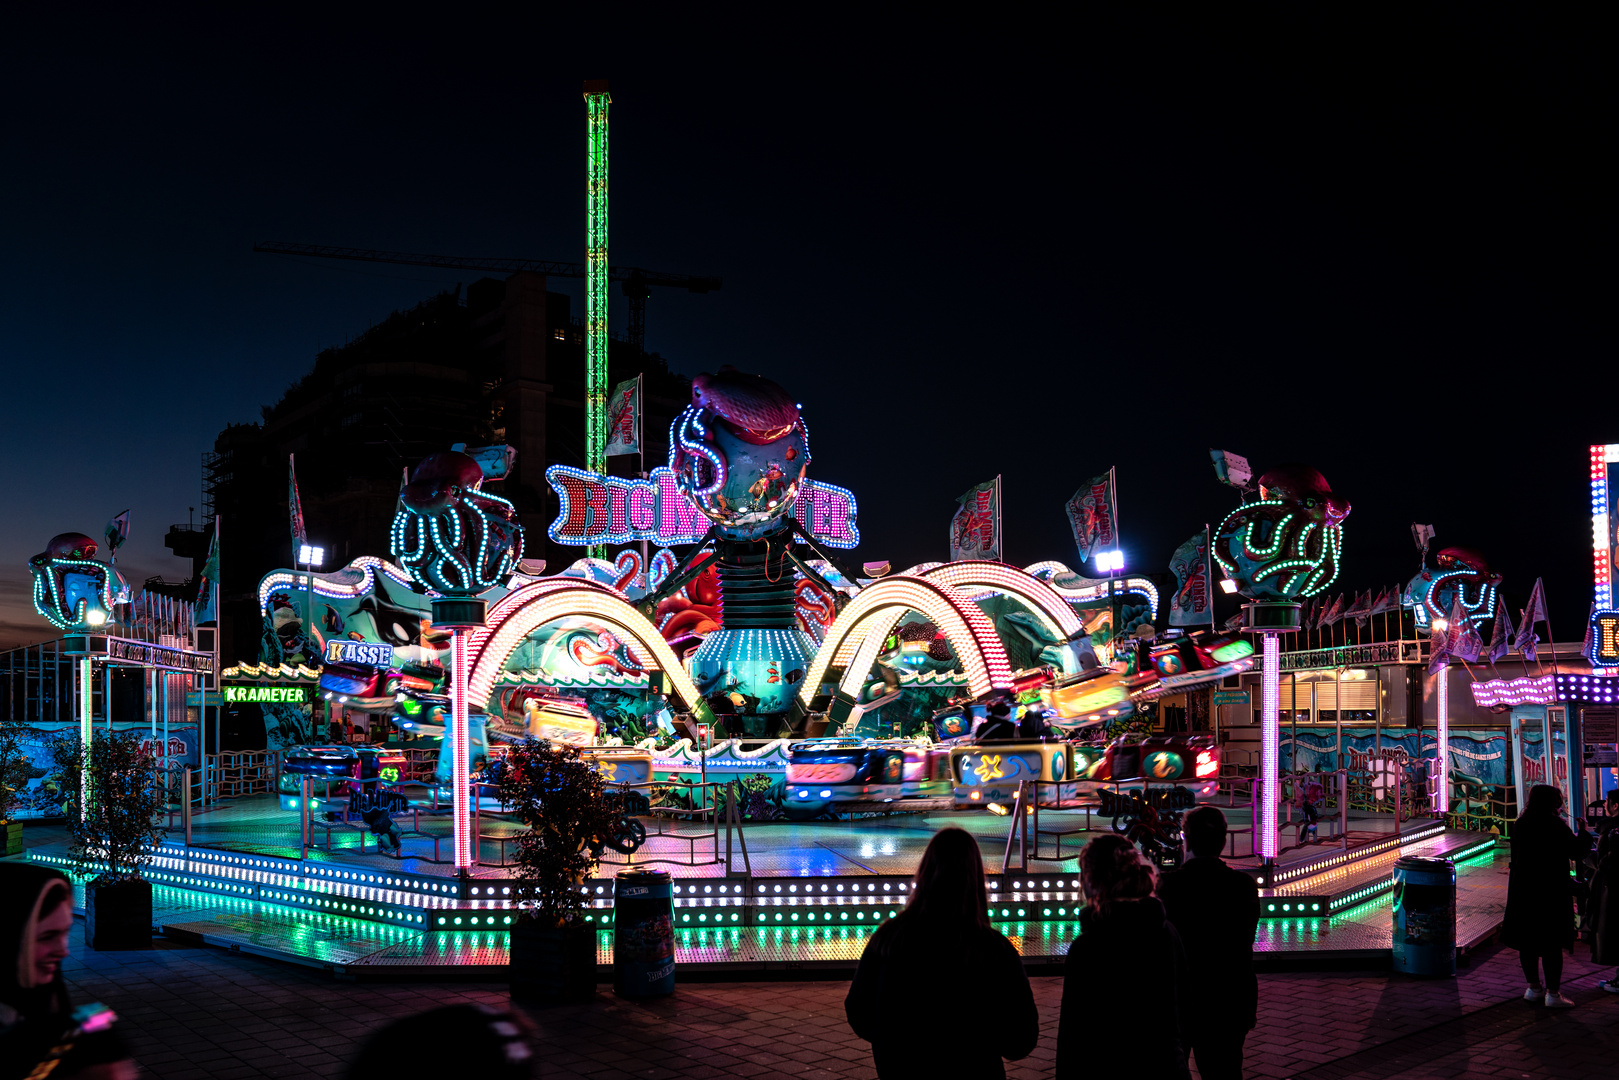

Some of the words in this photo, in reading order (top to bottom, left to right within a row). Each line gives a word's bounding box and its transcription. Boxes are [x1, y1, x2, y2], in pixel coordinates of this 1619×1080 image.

[976, 489, 992, 511] BIG
[1091, 482, 1106, 503] BIG
[557, 475, 655, 537] BIG
[660, 475, 851, 541] MTER
[978, 511, 993, 551] MONSTER
[329, 643, 390, 665] KASSE
[226, 687, 304, 702] KRAMEYER
[652, 685, 659, 694] 5
[1523, 757, 1542, 782] BIG
